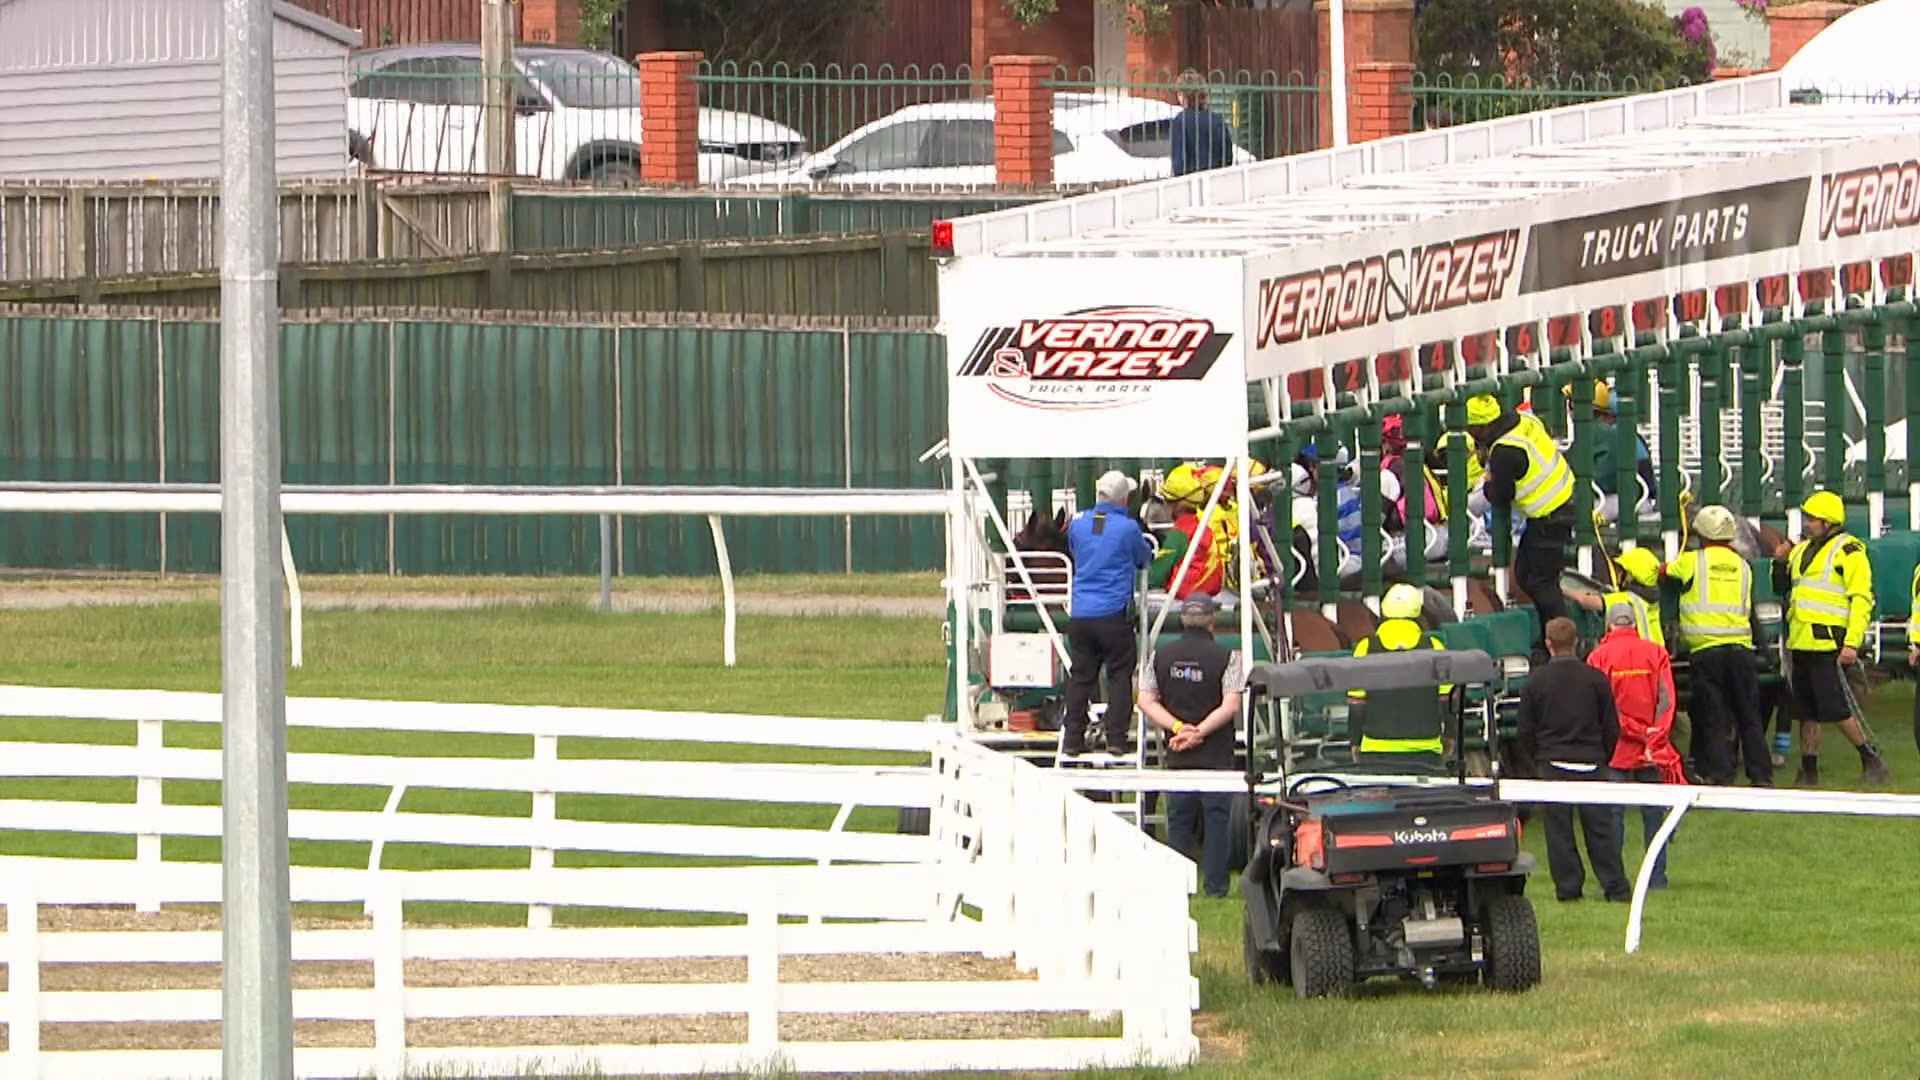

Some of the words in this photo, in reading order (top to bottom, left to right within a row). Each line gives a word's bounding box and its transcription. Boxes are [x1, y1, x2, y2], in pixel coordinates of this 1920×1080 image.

[1580, 217, 1663, 268] TRUCK
[1670, 203, 1749, 251] PARTS
[1763, 276, 1785, 308] 12
[1847, 263, 1868, 294] 14
[1682, 291, 1703, 322] 10
[1726, 285, 1742, 314] 11
[1018, 319, 1213, 350] VERNON
[1560, 316, 1573, 346] 7
[1601, 307, 1617, 337] 8
[1517, 324, 1532, 353] 6
[1430, 341, 1446, 372] 4
[1028, 384, 1087, 393] TRUCK
[1344, 362, 1359, 393] 2
[1394, 829, 1448, 844] Kubota
